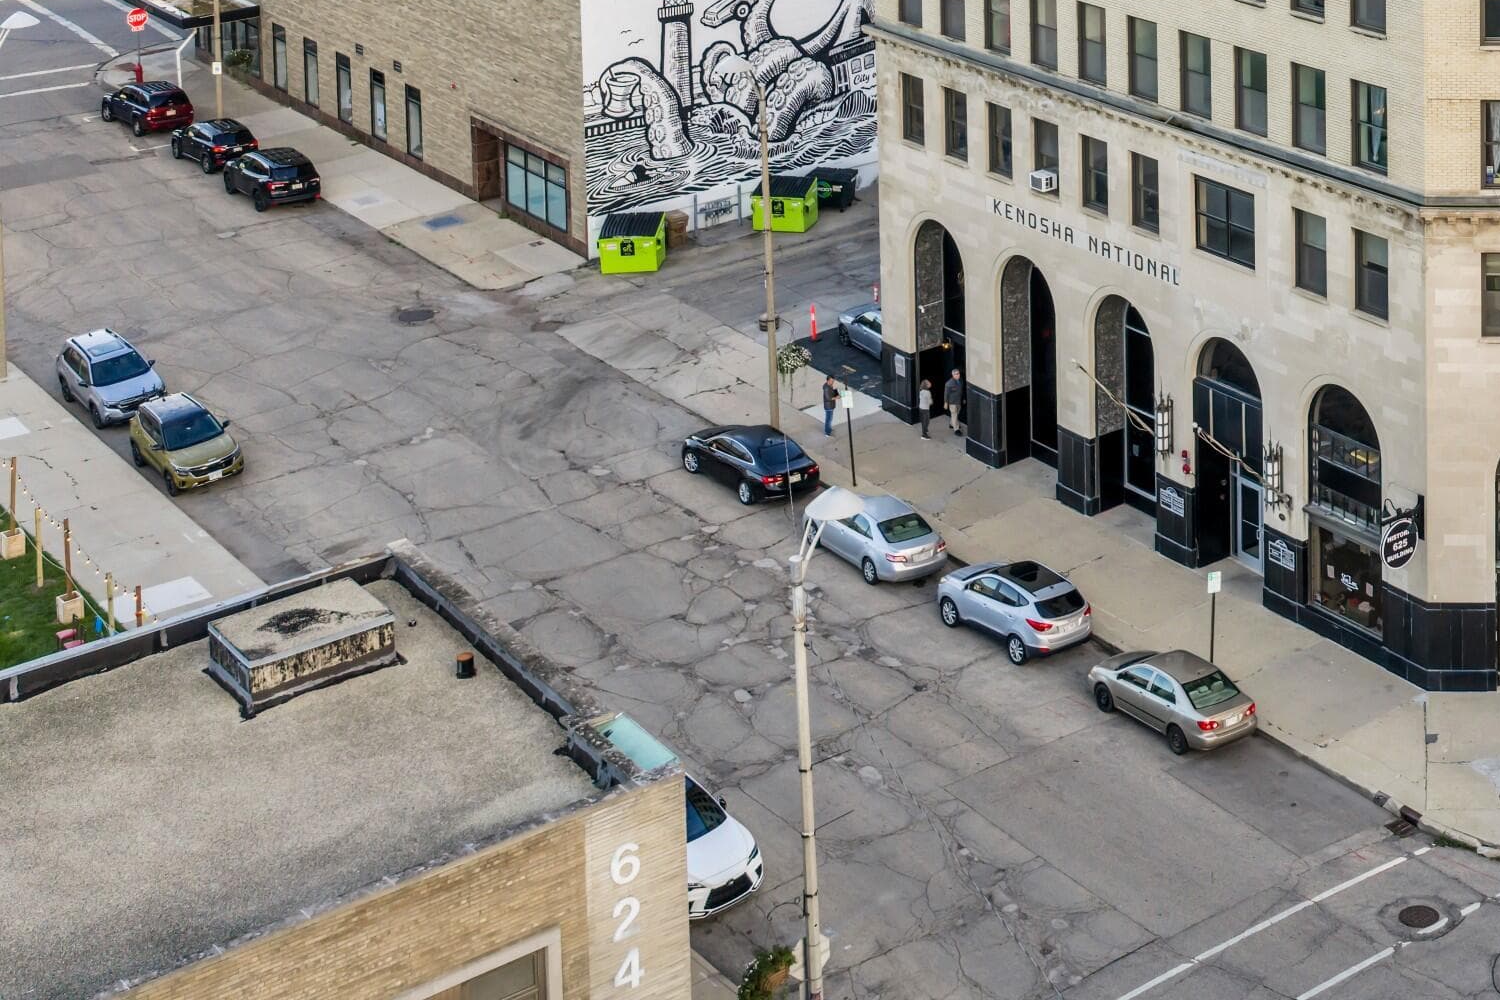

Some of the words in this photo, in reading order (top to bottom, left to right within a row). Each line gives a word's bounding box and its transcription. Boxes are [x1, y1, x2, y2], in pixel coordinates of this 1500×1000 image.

[128, 12, 147, 23] STOP
[853, 72, 870, 86] City
[993, 198, 1074, 245] KENOSHA
[1088, 235, 1180, 286] NATIONAL
[1393, 538, 1408, 552] 625
[1387, 546, 1414, 563] BUILDING
[610, 842, 646, 990] 624
